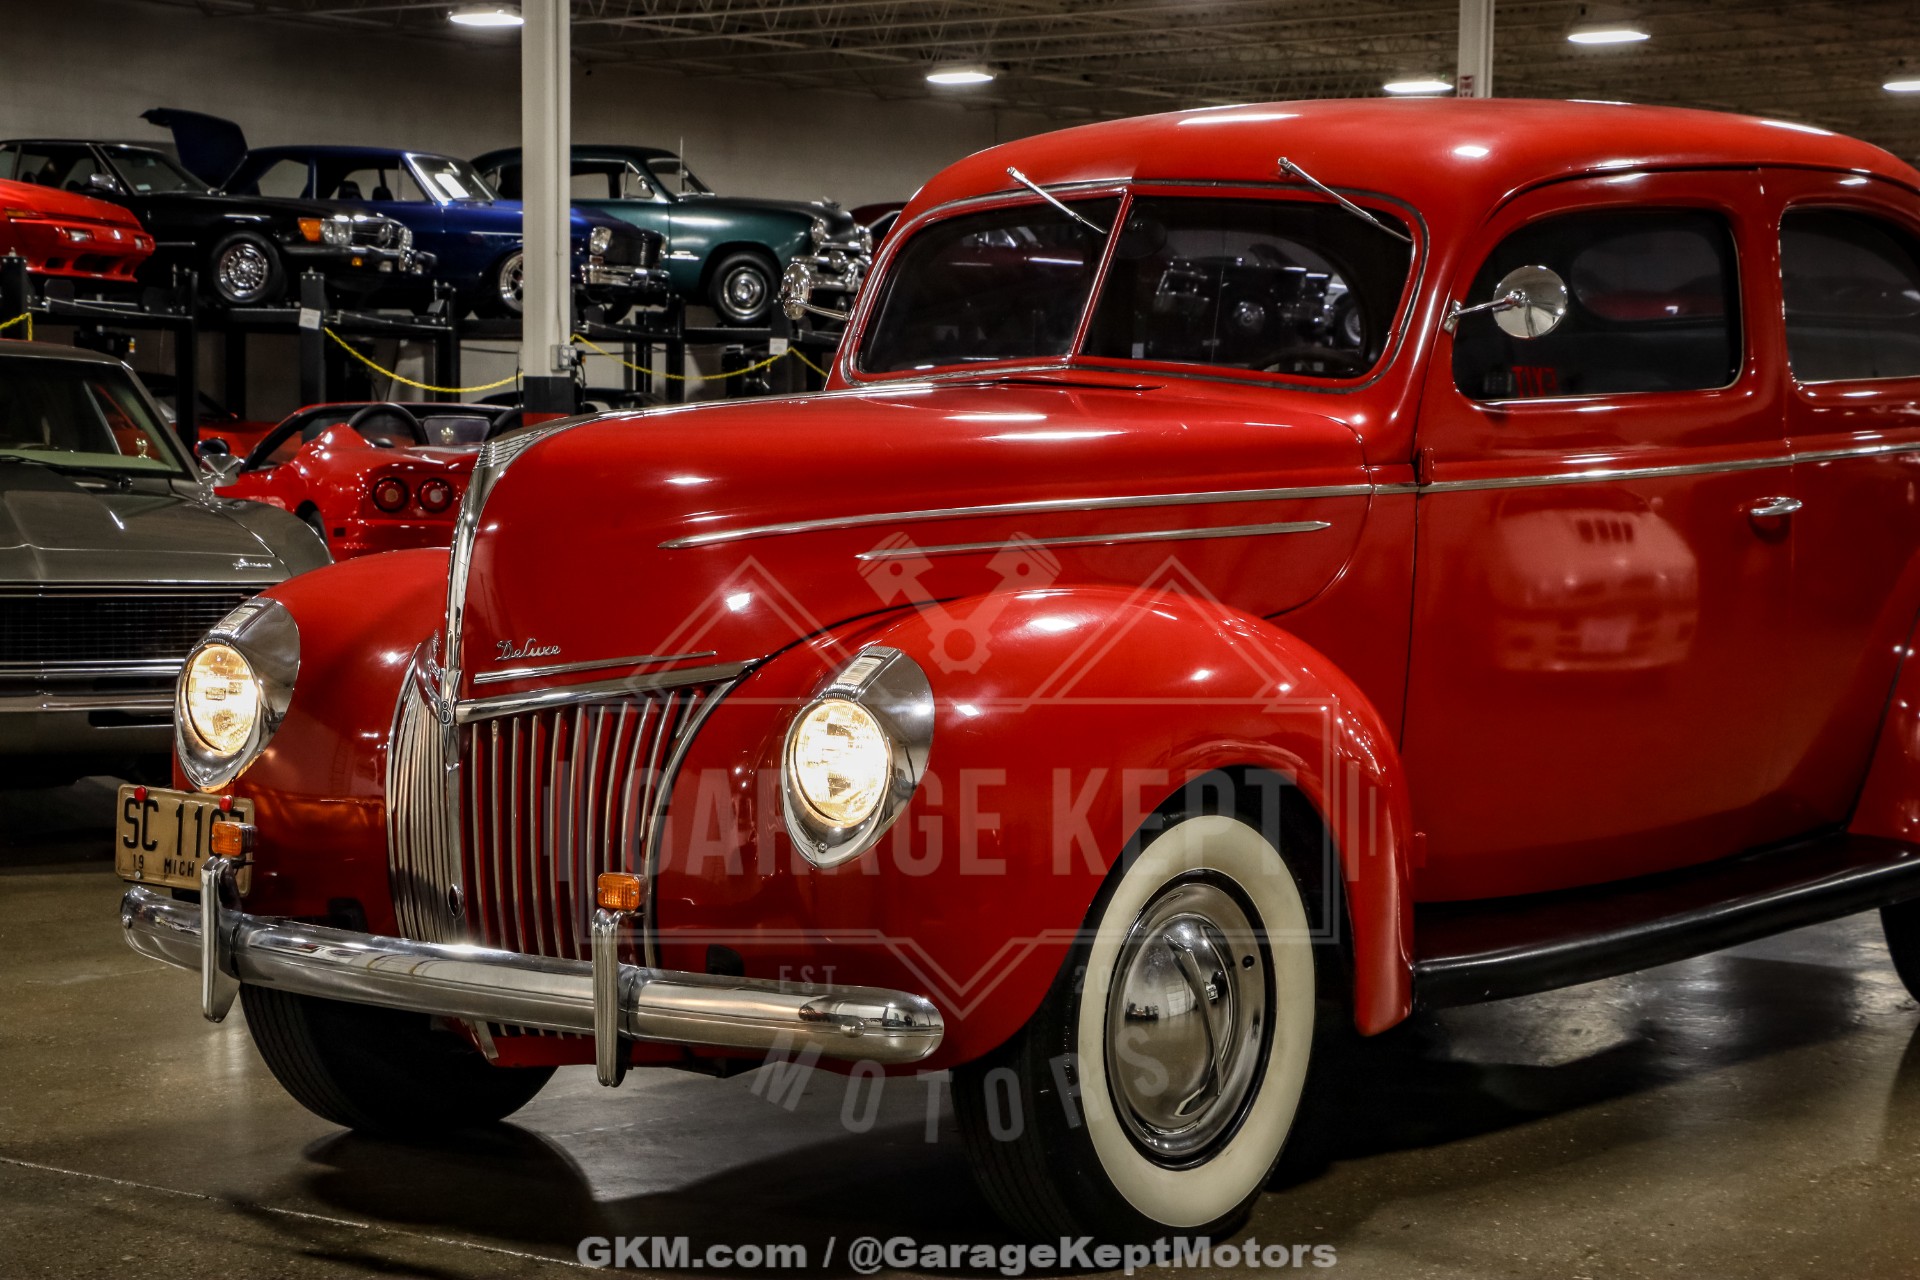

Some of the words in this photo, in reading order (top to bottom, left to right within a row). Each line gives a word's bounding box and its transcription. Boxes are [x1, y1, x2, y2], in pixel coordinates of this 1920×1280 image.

[123, 797, 159, 851] SC
[175, 803, 245, 858] 11
[163, 857, 195, 877] MICH
